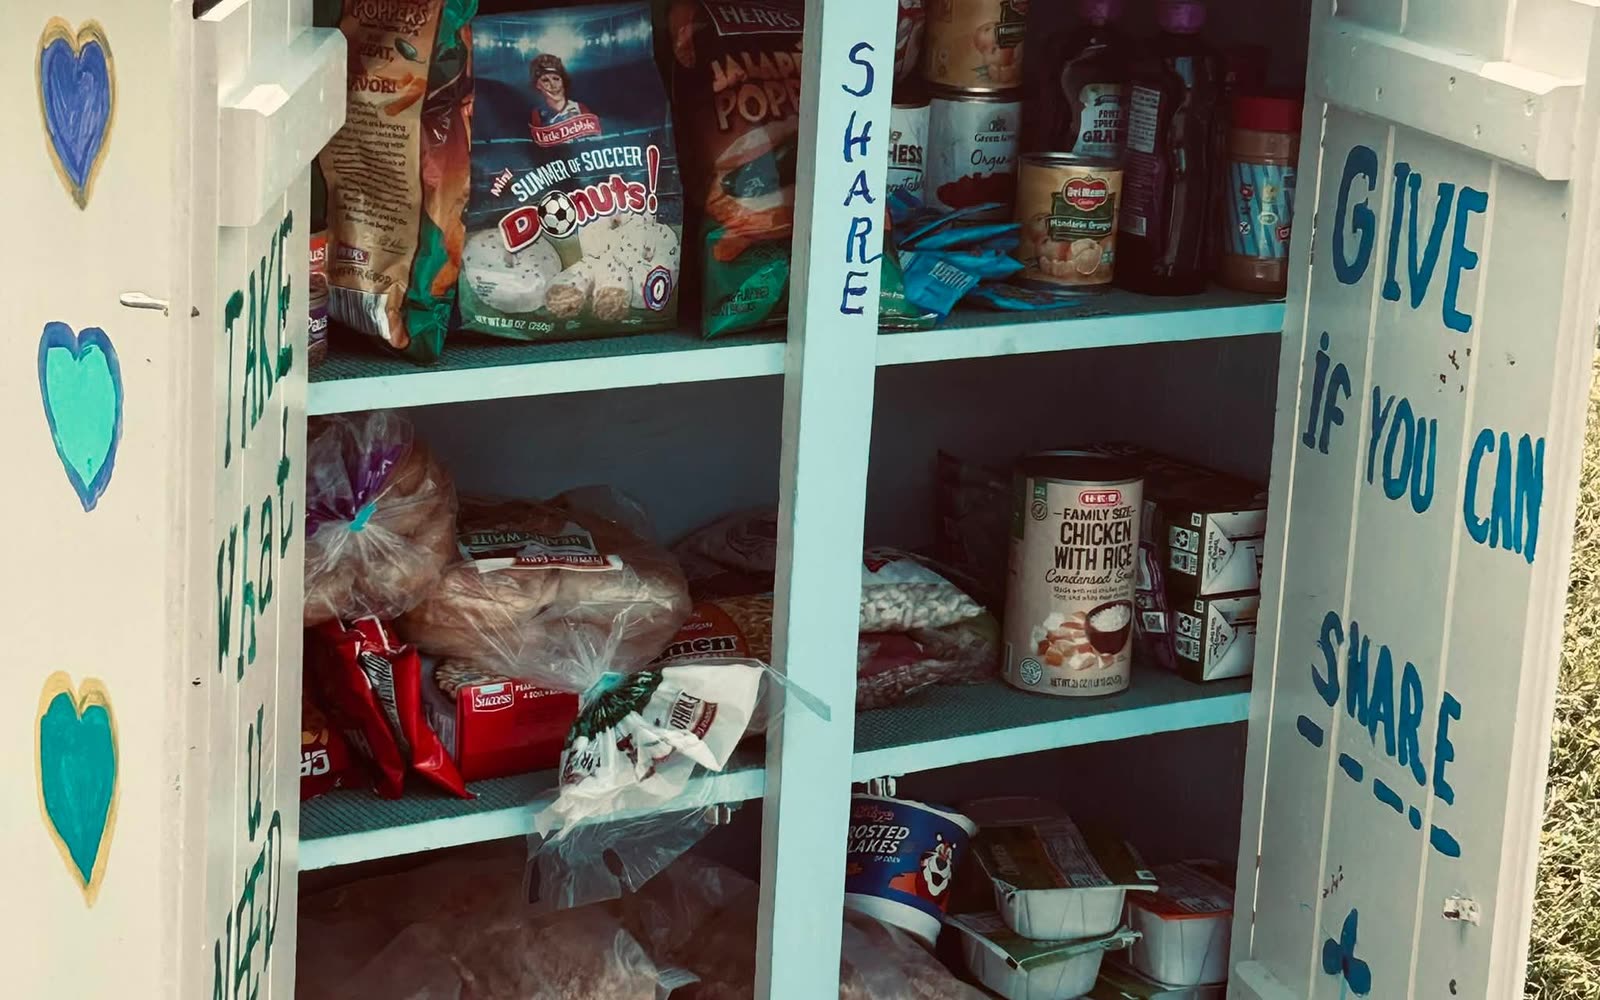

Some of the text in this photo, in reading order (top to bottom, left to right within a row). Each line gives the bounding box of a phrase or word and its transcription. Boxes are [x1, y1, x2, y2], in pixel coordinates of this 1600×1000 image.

[511, 146, 643, 203] SUMMER OF SOCCER
[840, 41, 883, 316] SHARE
[1332, 144, 1489, 333] GIVE
[224, 208, 293, 469] TAKE
[1367, 385, 1438, 515] YOU
[1464, 428, 1546, 565] CAN
[1063, 506, 1132, 521] FAMILY SIZE
[1060, 519, 1132, 546] CHICKEN
[1054, 543, 1133, 571] WITH RICE
[1045, 568, 1112, 585] Condensed
[474, 693, 512, 708] Success
[1311, 610, 1461, 805] SHARE
[847, 839, 900, 854] LAKES
[849, 824, 911, 841] ROSTED
